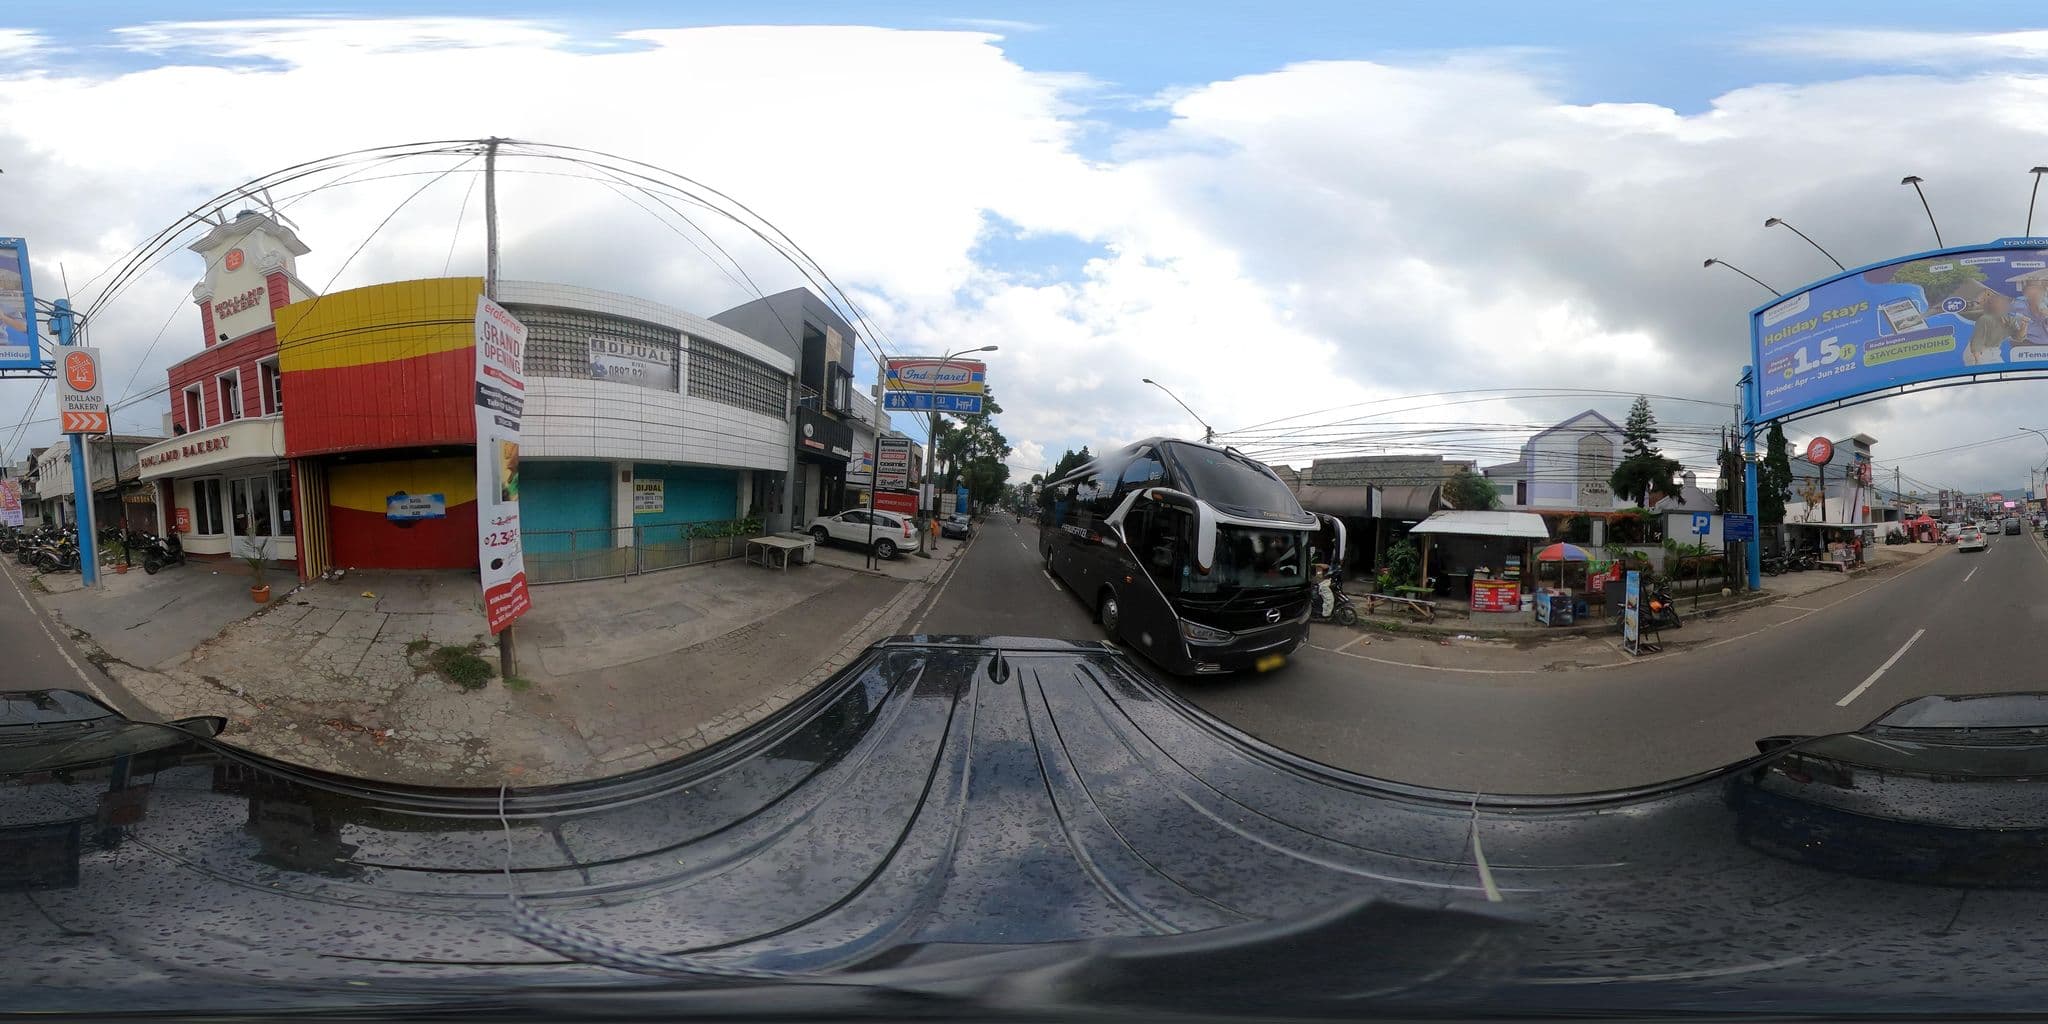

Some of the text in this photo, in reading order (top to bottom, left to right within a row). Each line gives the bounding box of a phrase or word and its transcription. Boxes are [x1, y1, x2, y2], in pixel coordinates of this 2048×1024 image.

[215, 286, 264, 313] HOLLAND
[1764, 317, 1818, 347] Holiday
[1822, 300, 1869, 323] Stays
[484, 320, 520, 358] GRAND
[608, 341, 668, 362] DIJUAL
[484, 342, 521, 375] OPENING
[1794, 336, 1840, 375] 1.5
[1794, 377, 1809, 388] Apr
[1817, 370, 1833, 380] Jun
[1834, 361, 1857, 373] 2022
[65, 394, 102, 403] HOLLAND
[182, 436, 230, 457] BAKERY
[636, 484, 662, 492] DIJUAL
